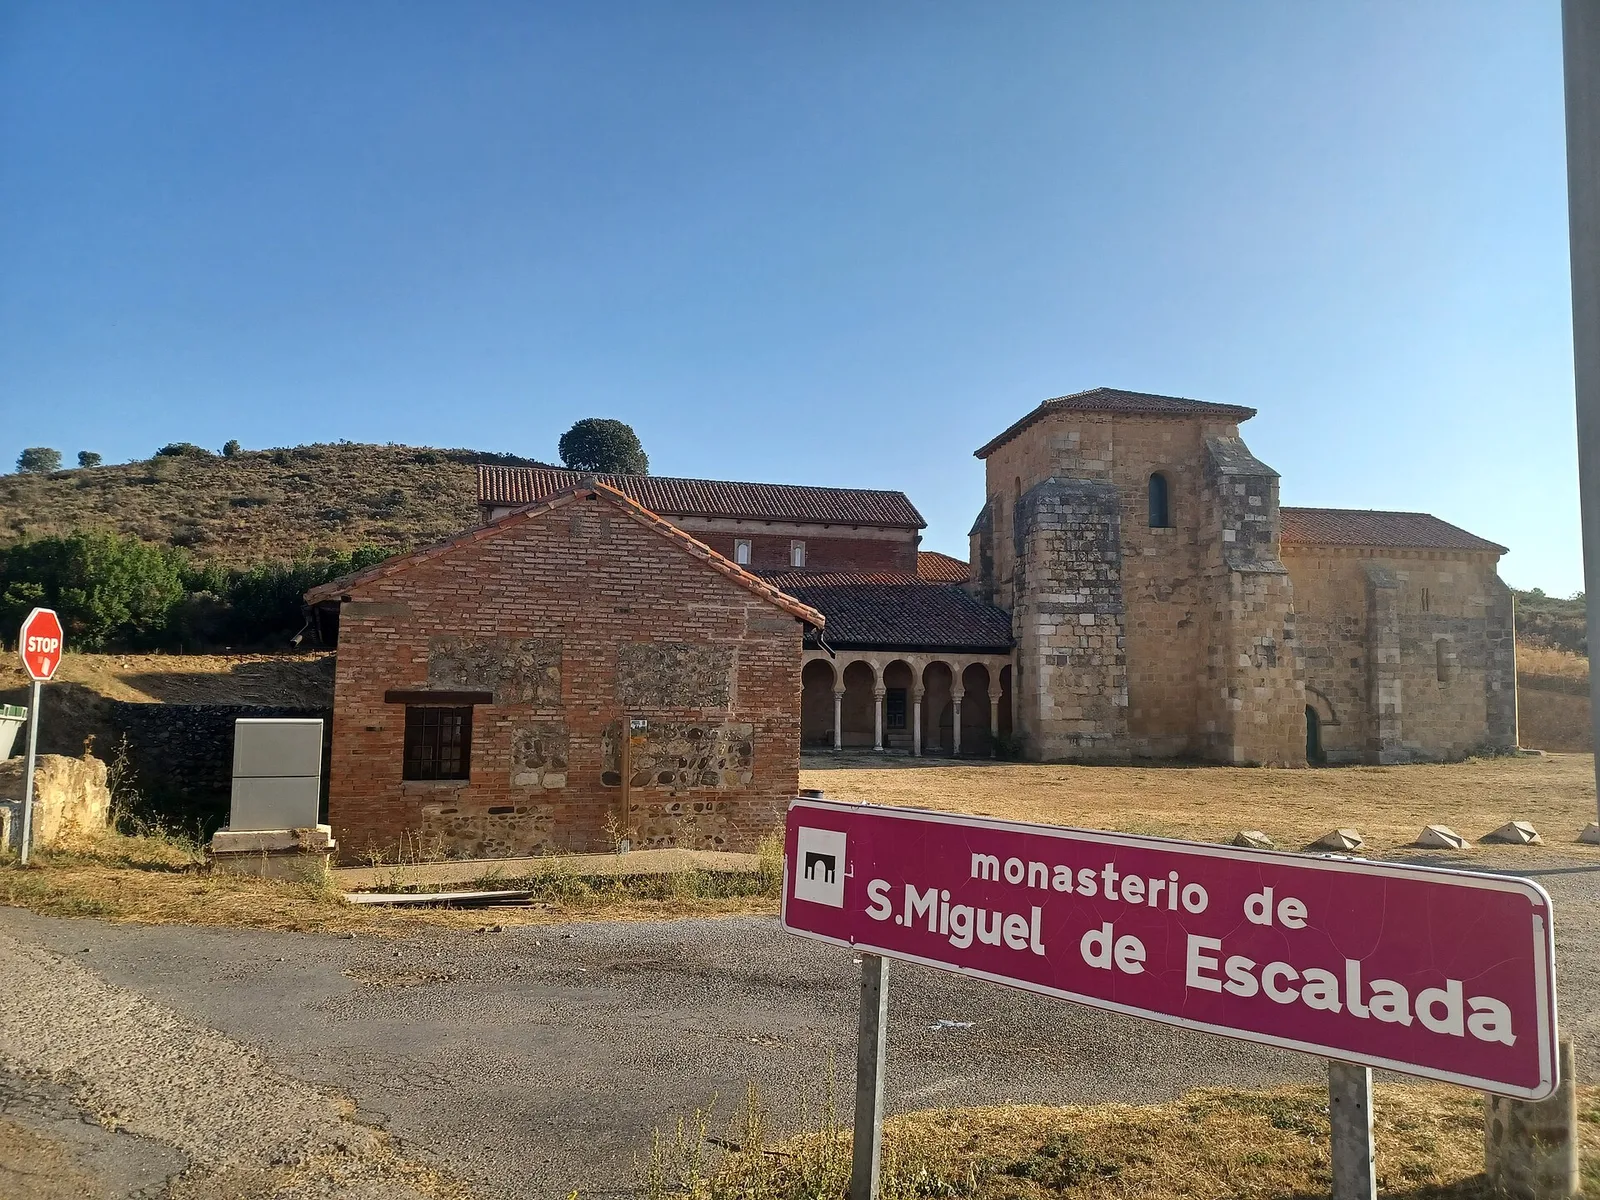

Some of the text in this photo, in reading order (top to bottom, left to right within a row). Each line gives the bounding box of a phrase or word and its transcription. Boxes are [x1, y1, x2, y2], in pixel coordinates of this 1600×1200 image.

[28, 636, 59, 653] STOP
[971, 853, 1308, 929] monasterio de
[864, 878, 1518, 1047] S.Miguel de Escalada
